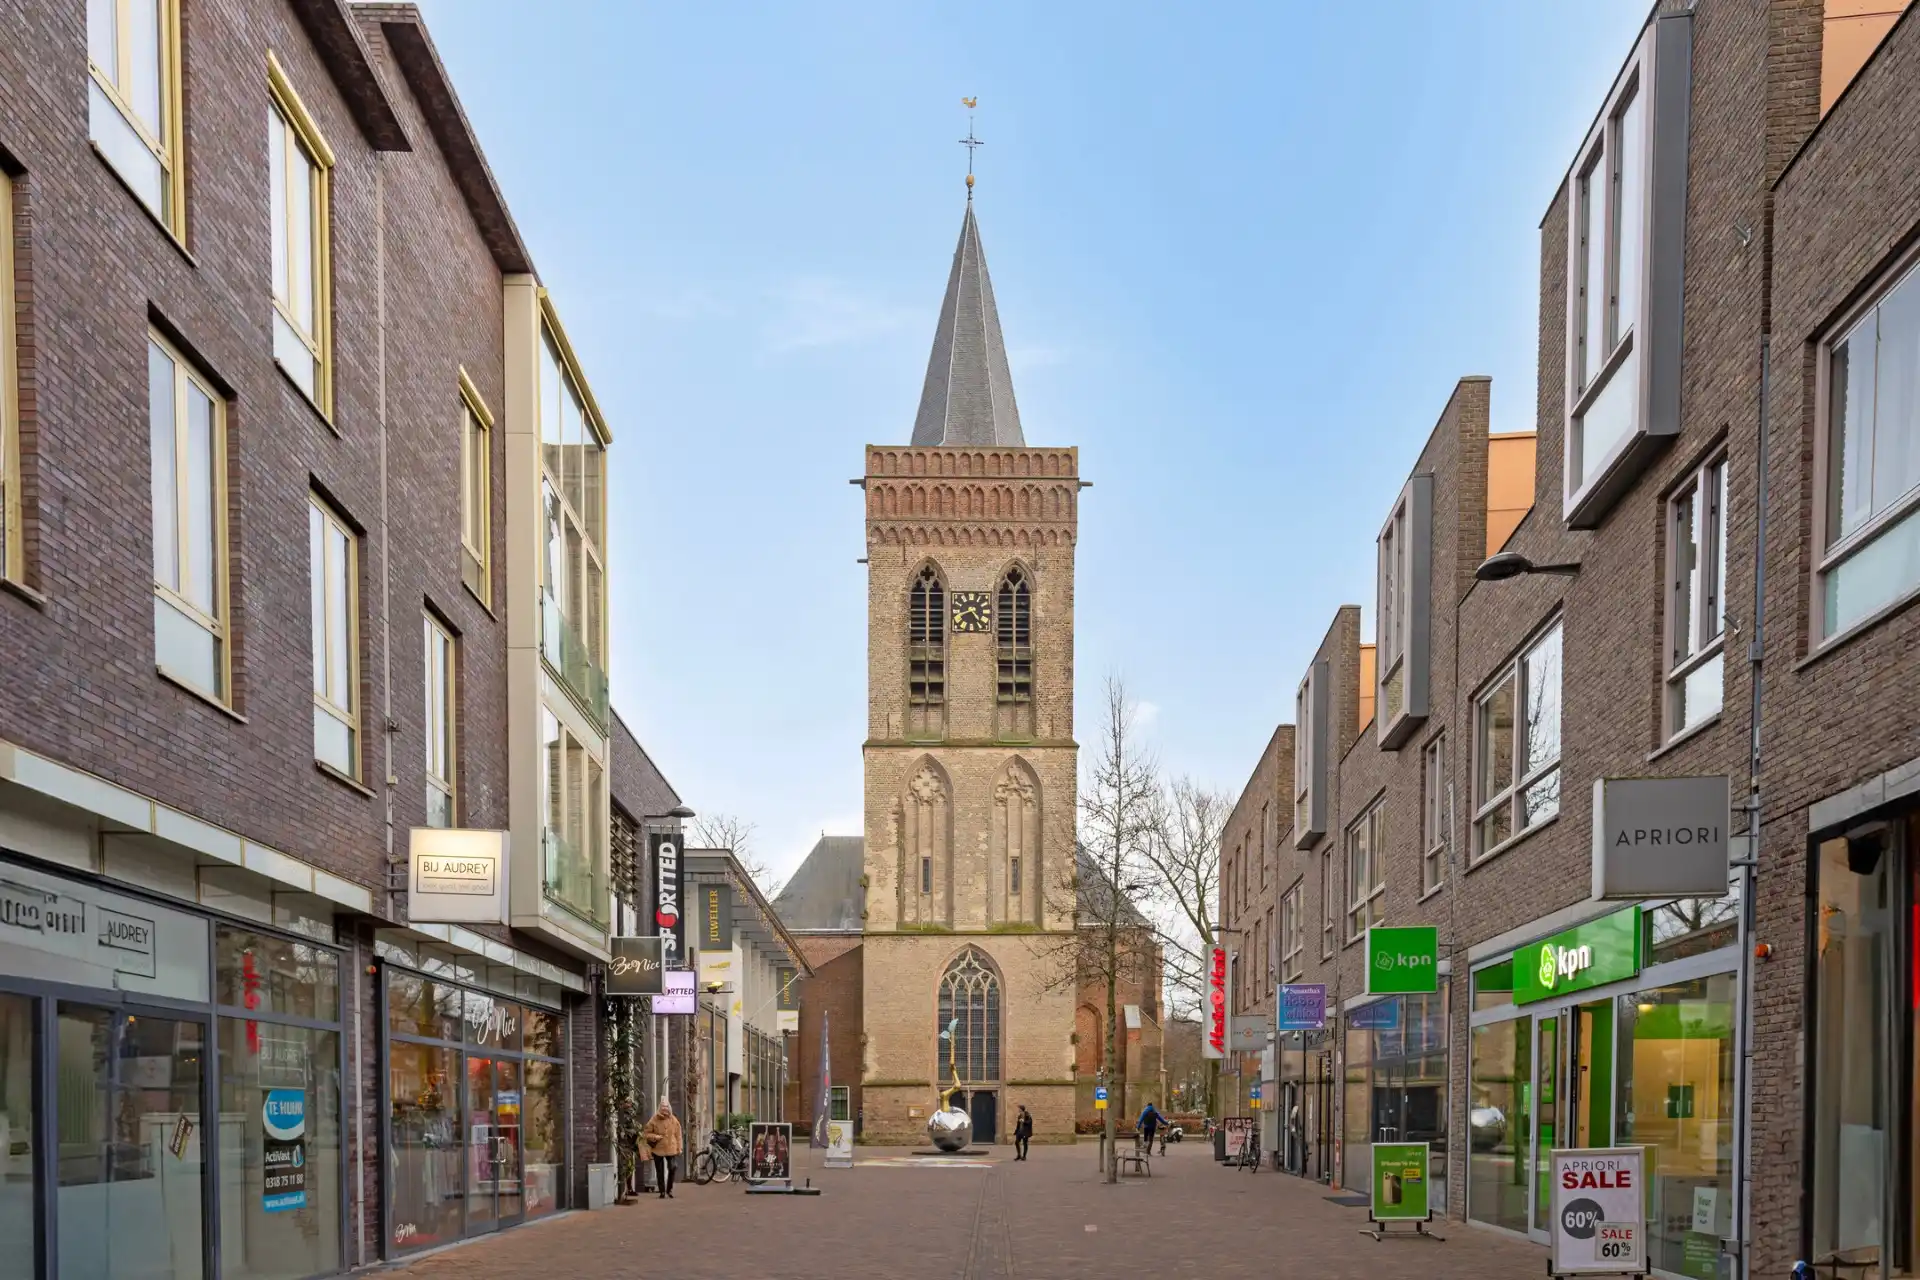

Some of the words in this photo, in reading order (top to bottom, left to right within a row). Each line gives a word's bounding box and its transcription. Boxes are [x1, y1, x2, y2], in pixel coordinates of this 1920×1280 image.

[1615, 826, 1719, 847] APRIORI
[423, 861, 439, 873] BIJ
[443, 862, 489, 875] AUDREY
[709, 889, 720, 943] JUWELIER
[107, 919, 149, 945] AUDREY
[1397, 953, 1432, 967] kpn
[1557, 944, 1592, 980] kpn
[268, 1101, 279, 1116] TE
[280, 1101, 304, 1116] HUUR
[265, 1150, 291, 1163] ActiVast
[1562, 1160, 1621, 1172] APRIORI
[281, 1176, 289, 1187] 75
[1562, 1170, 1632, 1190] SALE
[1565, 1210, 1600, 1229] 60%
[1601, 1228, 1633, 1240] SALE
[1601, 1241, 1632, 1258] 60%
